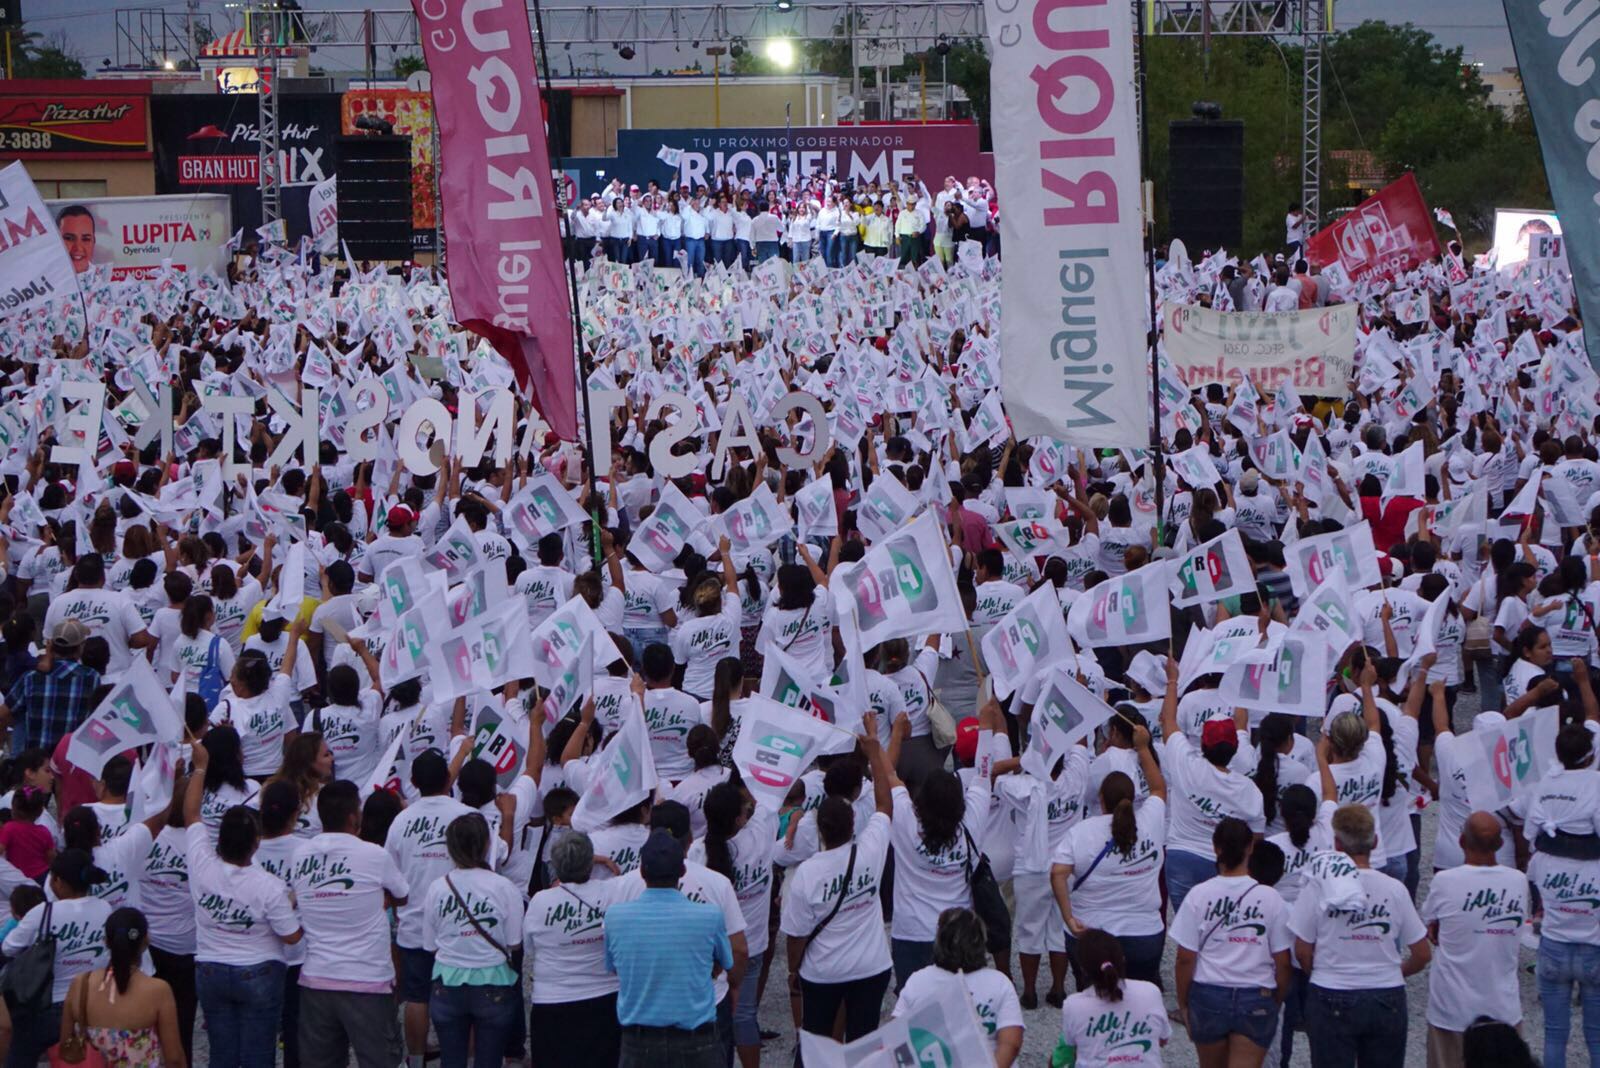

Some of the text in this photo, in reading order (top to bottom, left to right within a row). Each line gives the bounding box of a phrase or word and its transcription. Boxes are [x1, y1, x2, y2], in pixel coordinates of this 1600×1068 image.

[230, 123, 320, 143] Piz Hut
[693, 135, 905, 148] TU PRÓXIMO GOBERNADOR
[182, 159, 257, 179] GRAN HUT
[122, 222, 198, 245] LUPITA
[1183, 556, 1219, 583] PRI
[474, 726, 515, 772] PRI
[403, 815, 439, 838] ¡Ah!
[294, 853, 328, 880] ¡Ah!
[1542, 872, 1579, 890] ¡Ah!
[1462, 887, 1507, 912] ¡Ah!
[545, 899, 584, 926] ¡Ah!
[1086, 1010, 1131, 1038] ¡Ah!
[1129, 1013, 1153, 1039] sí.
